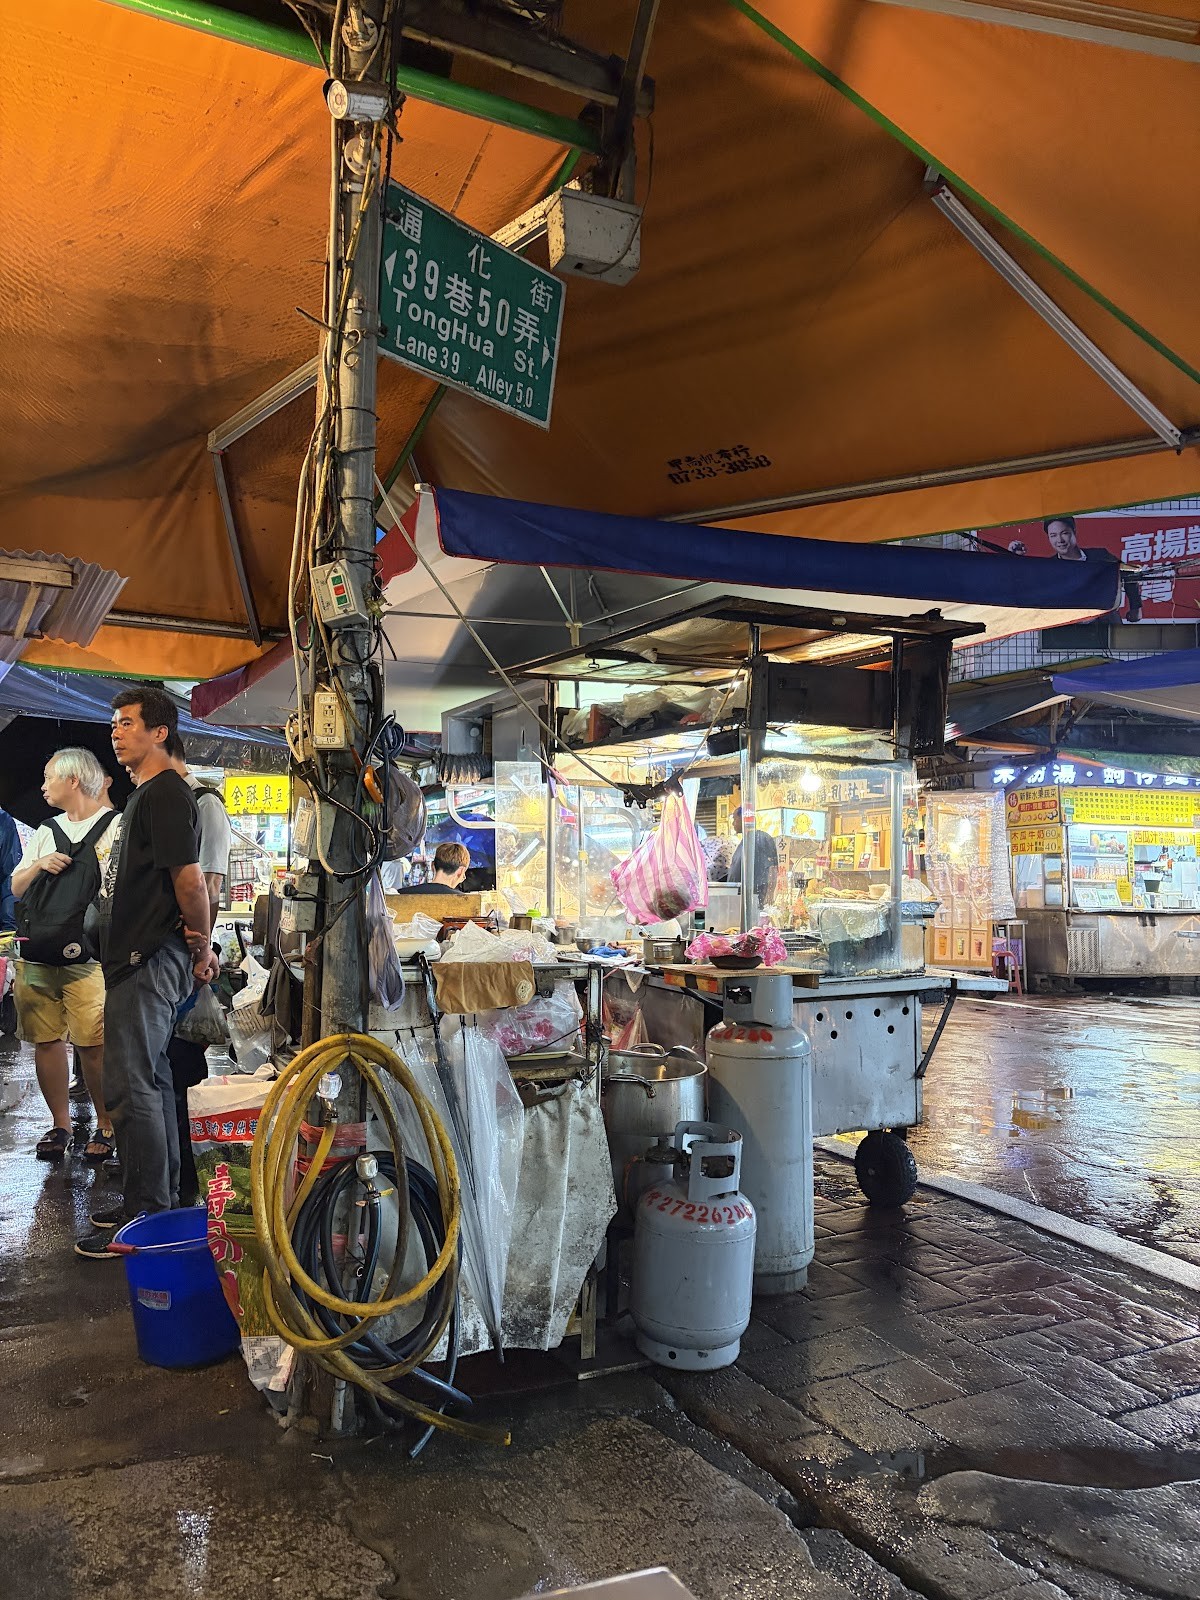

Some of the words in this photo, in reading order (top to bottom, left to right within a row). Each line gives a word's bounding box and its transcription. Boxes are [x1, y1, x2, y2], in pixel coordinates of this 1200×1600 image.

[399, 199, 554, 314] 通化街
[402, 248, 541, 350] 39巷50弄
[392, 287, 495, 358] TongHua
[514, 350, 540, 380] St.
[395, 325, 438, 364] Lane
[440, 346, 460, 374] 39
[476, 364, 513, 397] Alley
[516, 381, 533, 408] 50
[1012, 842, 1034, 852] 西瓜汁
